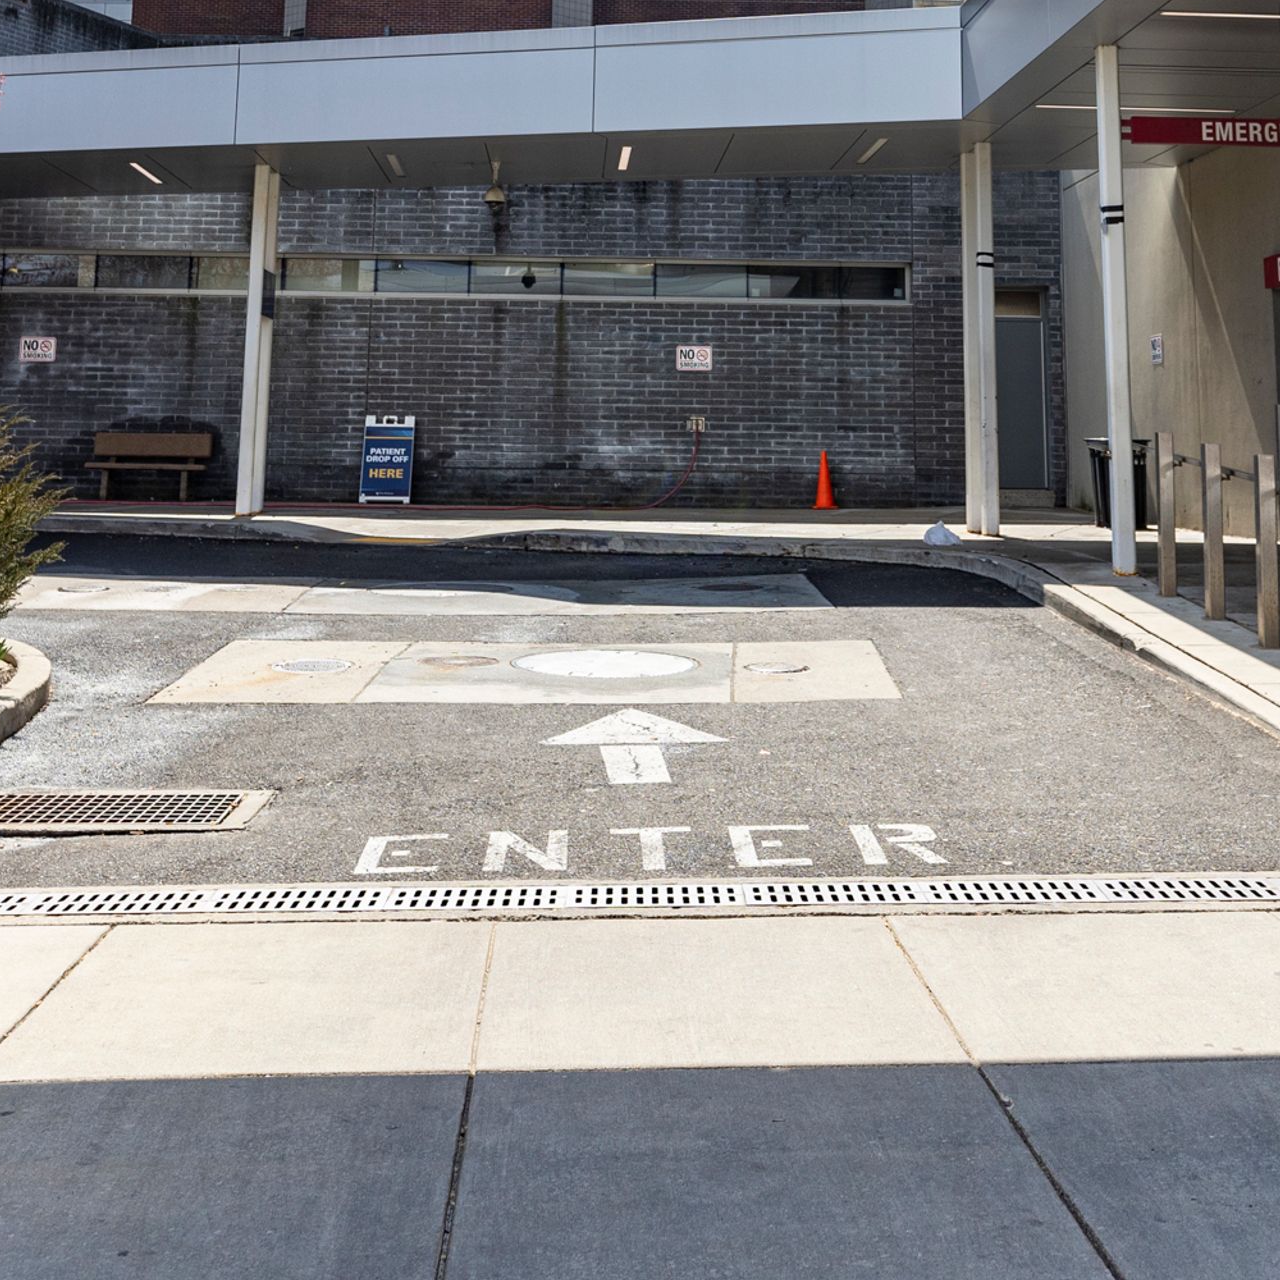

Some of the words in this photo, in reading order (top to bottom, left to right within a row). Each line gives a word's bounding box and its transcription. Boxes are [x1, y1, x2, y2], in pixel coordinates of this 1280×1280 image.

[23, 340, 39, 351] NO
[680, 349, 695, 360] NO
[370, 447, 406, 456] PATIENT
[366, 455, 391, 463] DROP
[392, 455, 409, 463] OFF
[368, 468, 404, 479] HERE
[351, 823, 951, 875] ENTER
